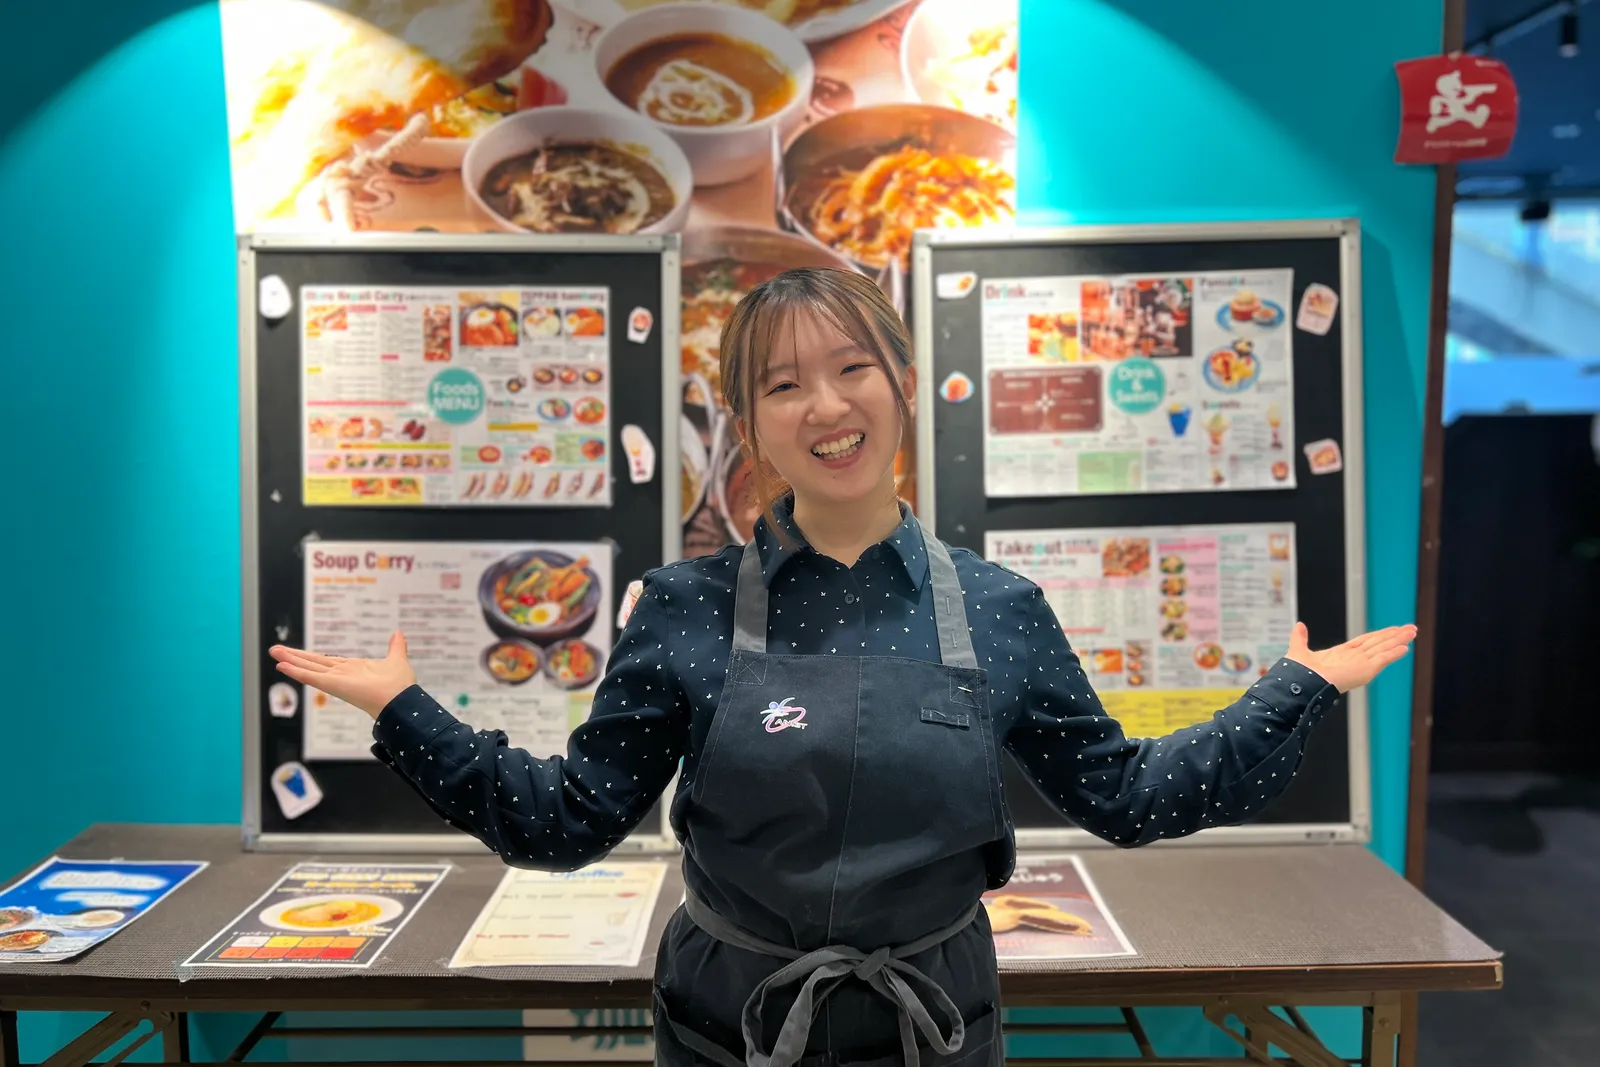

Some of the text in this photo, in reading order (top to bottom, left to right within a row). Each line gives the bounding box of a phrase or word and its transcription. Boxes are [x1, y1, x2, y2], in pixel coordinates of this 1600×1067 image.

[985, 283, 1026, 299] Drink
[433, 381, 479, 395] Foods
[433, 396, 480, 410] MENU
[994, 540, 1062, 555] Takeout
[313, 550, 415, 574] Soup Curry
